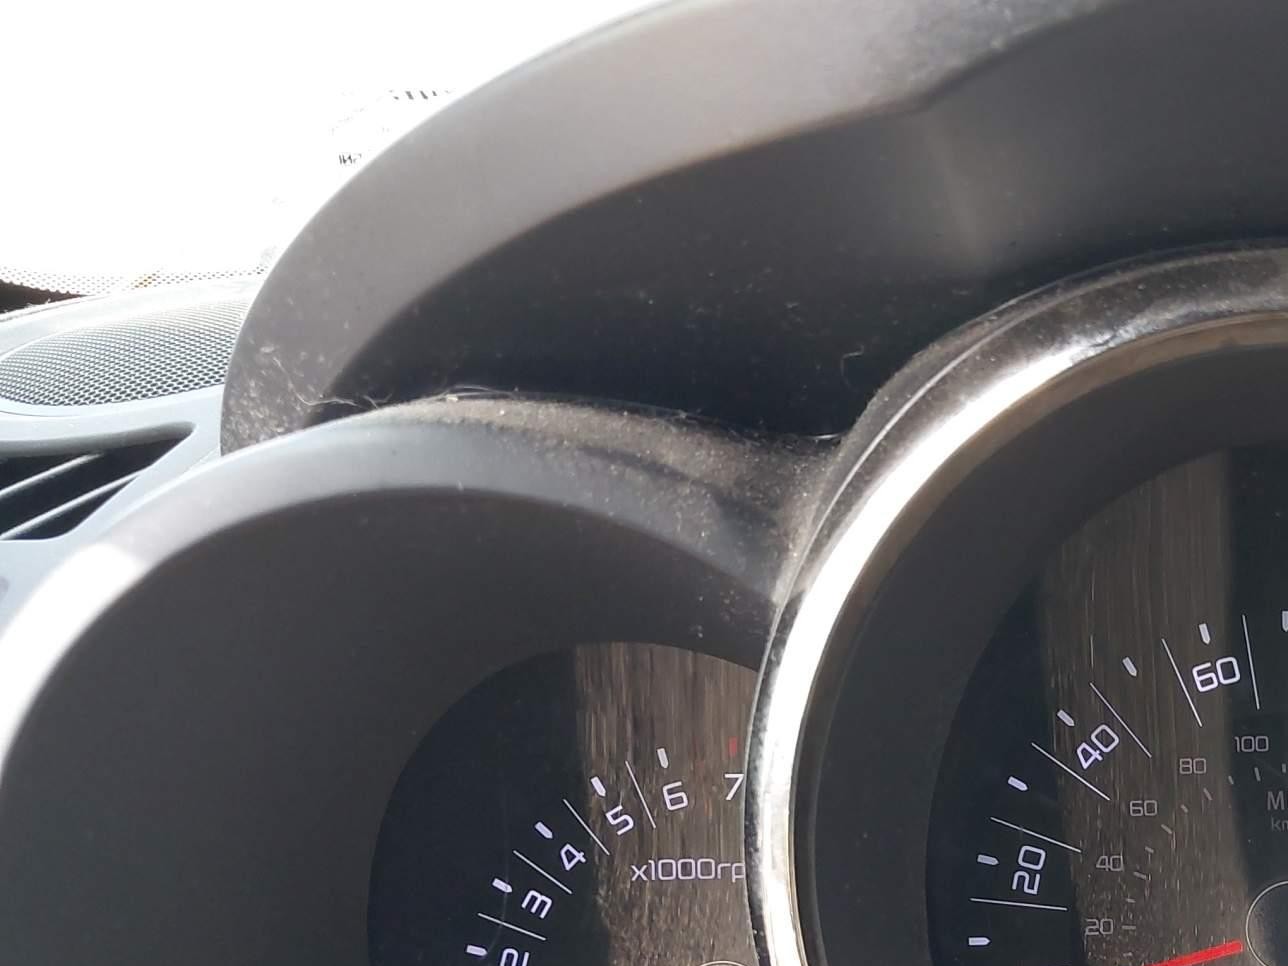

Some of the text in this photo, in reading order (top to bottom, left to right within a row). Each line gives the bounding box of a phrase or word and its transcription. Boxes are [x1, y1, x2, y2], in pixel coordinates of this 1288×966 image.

[1192, 656, 1241, 692] 60
[1075, 724, 1120, 769] 40
[1234, 736, 1269, 752] 100
[1179, 758, 1207, 775] 80
[662, 781, 689, 811] 6
[724, 773, 745, 801] 7
[605, 805, 634, 835] 5
[1129, 800, 1158, 816] 60
[559, 843, 586, 871] 4
[1012, 845, 1046, 895] 20
[1096, 855, 1124, 872] 40
[521, 890, 552, 919] 3
[1085, 918, 1114, 935] 20
